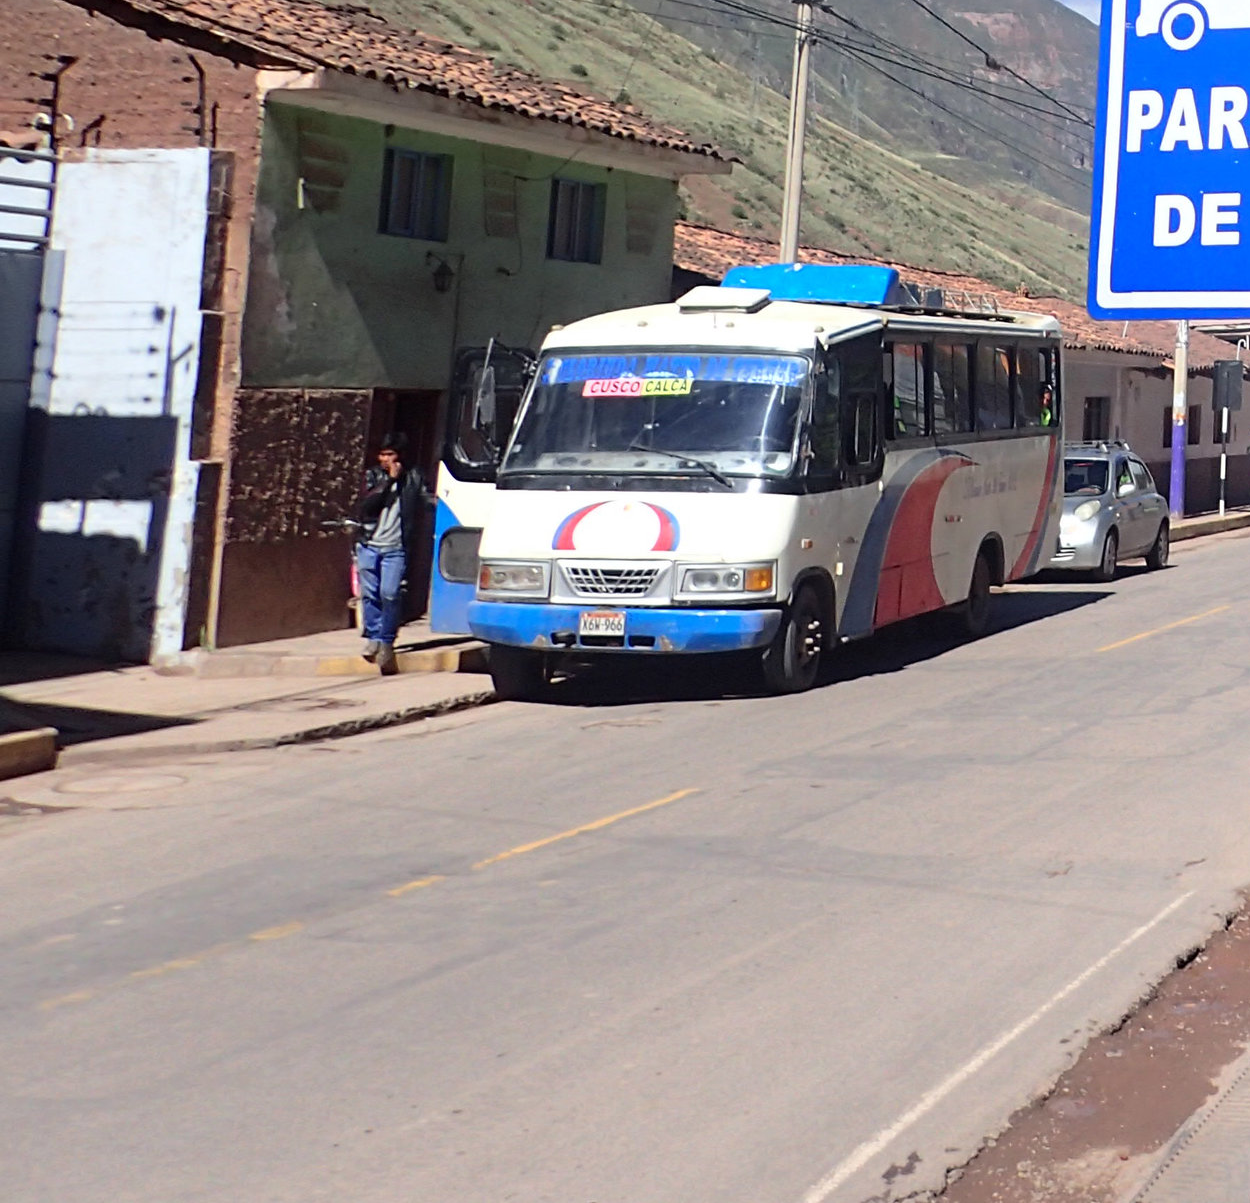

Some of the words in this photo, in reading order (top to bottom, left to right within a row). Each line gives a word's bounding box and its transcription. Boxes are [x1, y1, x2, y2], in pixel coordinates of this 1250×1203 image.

[1153, 192, 1241, 247] DE
[590, 381, 641, 393] CUSCO
[645, 379, 687, 392] CALCA
